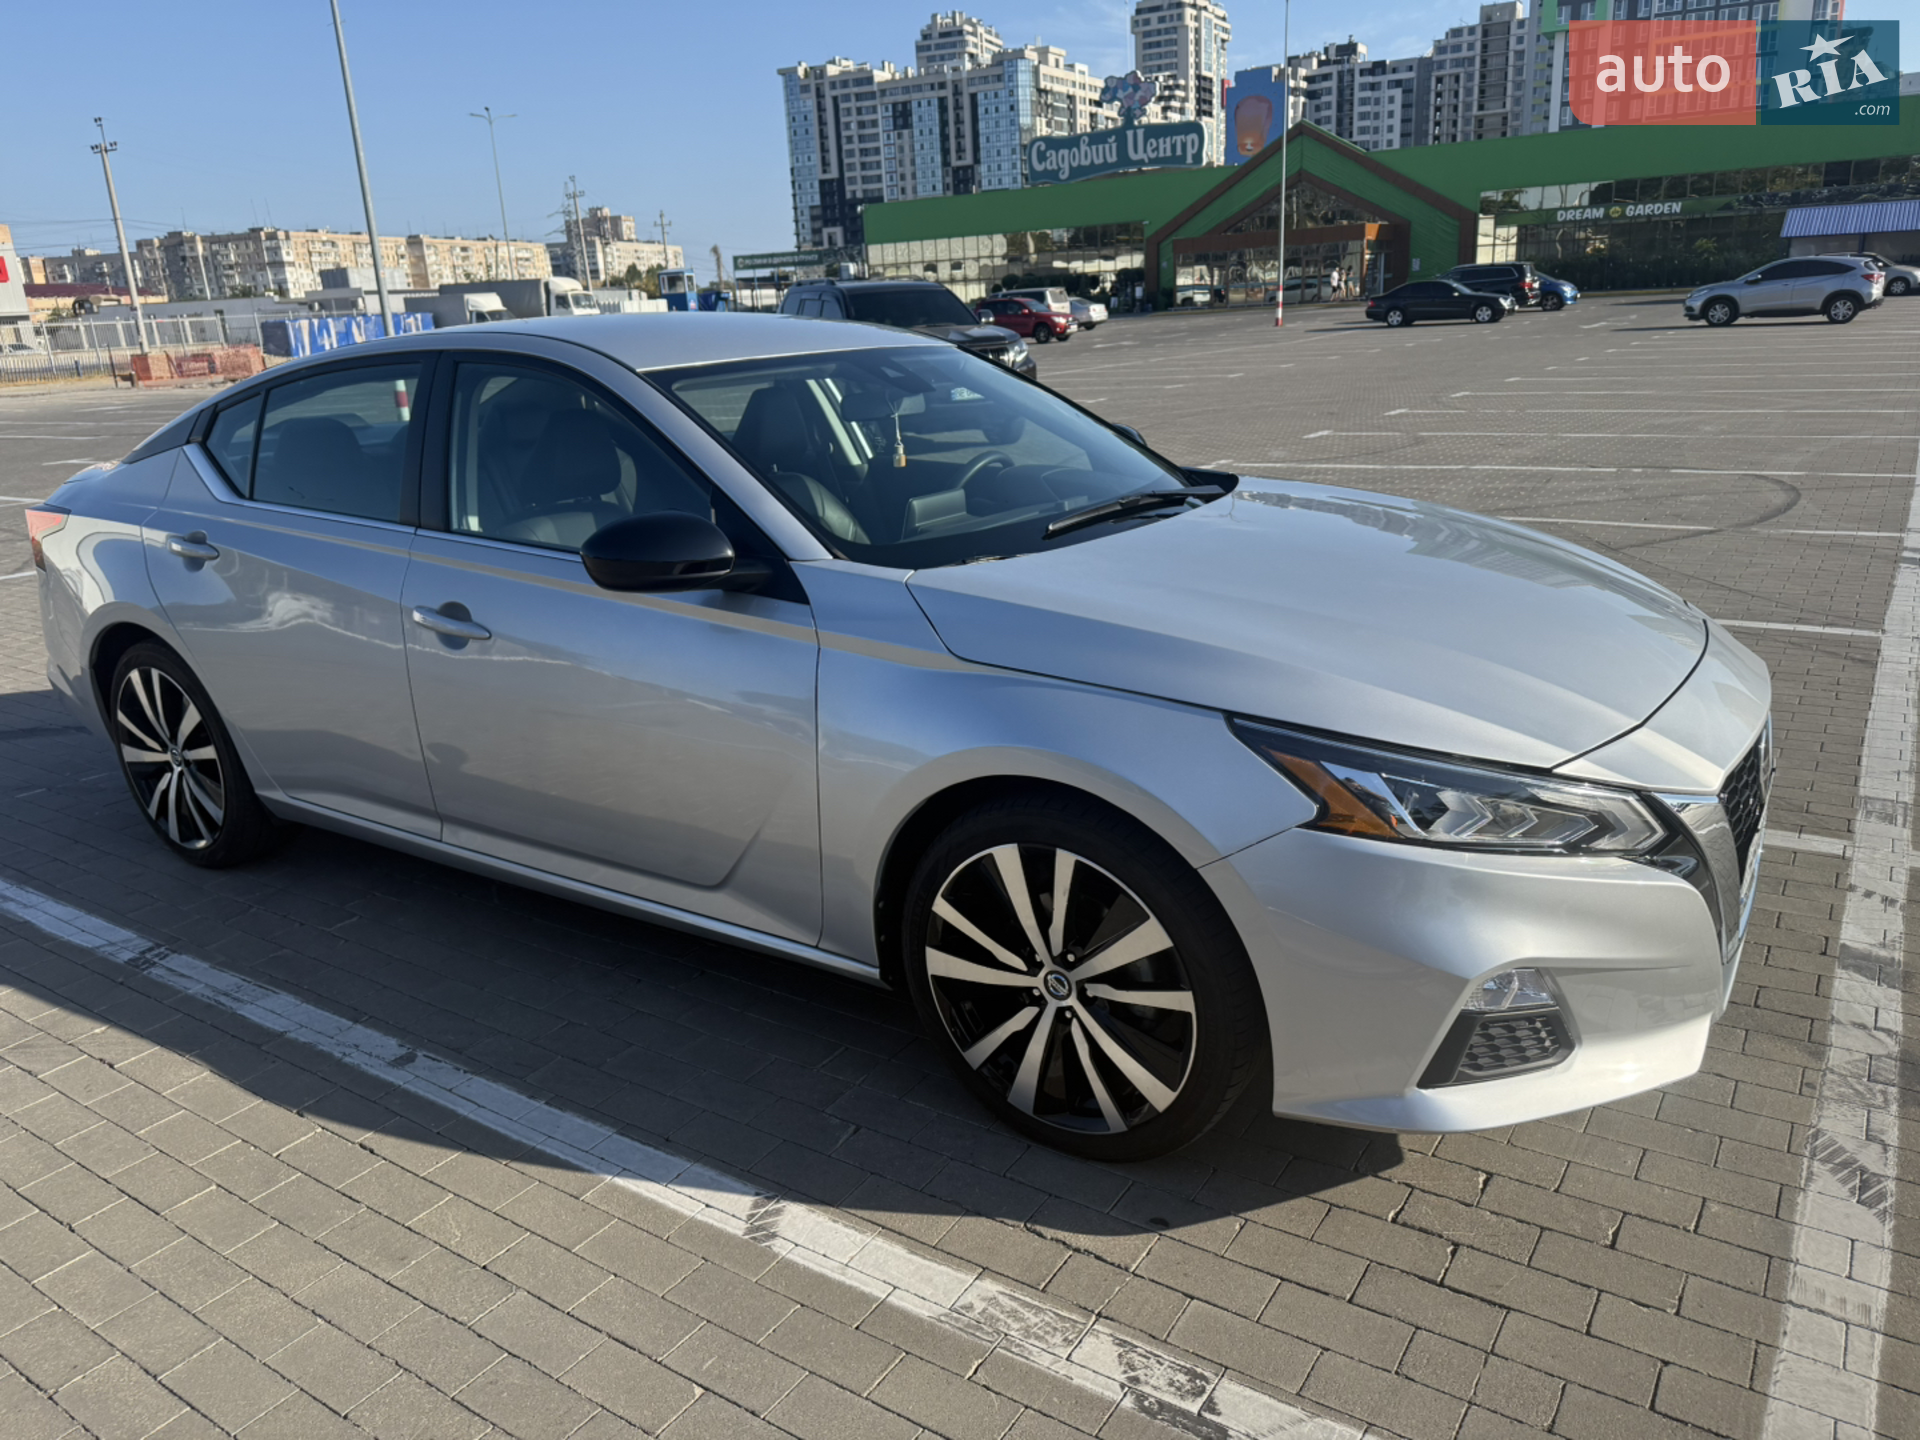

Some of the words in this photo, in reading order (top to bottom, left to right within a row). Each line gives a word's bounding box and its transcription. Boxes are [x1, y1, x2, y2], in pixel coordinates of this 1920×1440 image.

[1031, 136, 1117, 179] Садовий
[1126, 128, 1199, 164] Центр
[1557, 208, 1604, 222] DREAM
[1625, 202, 1682, 217] GARDEN
